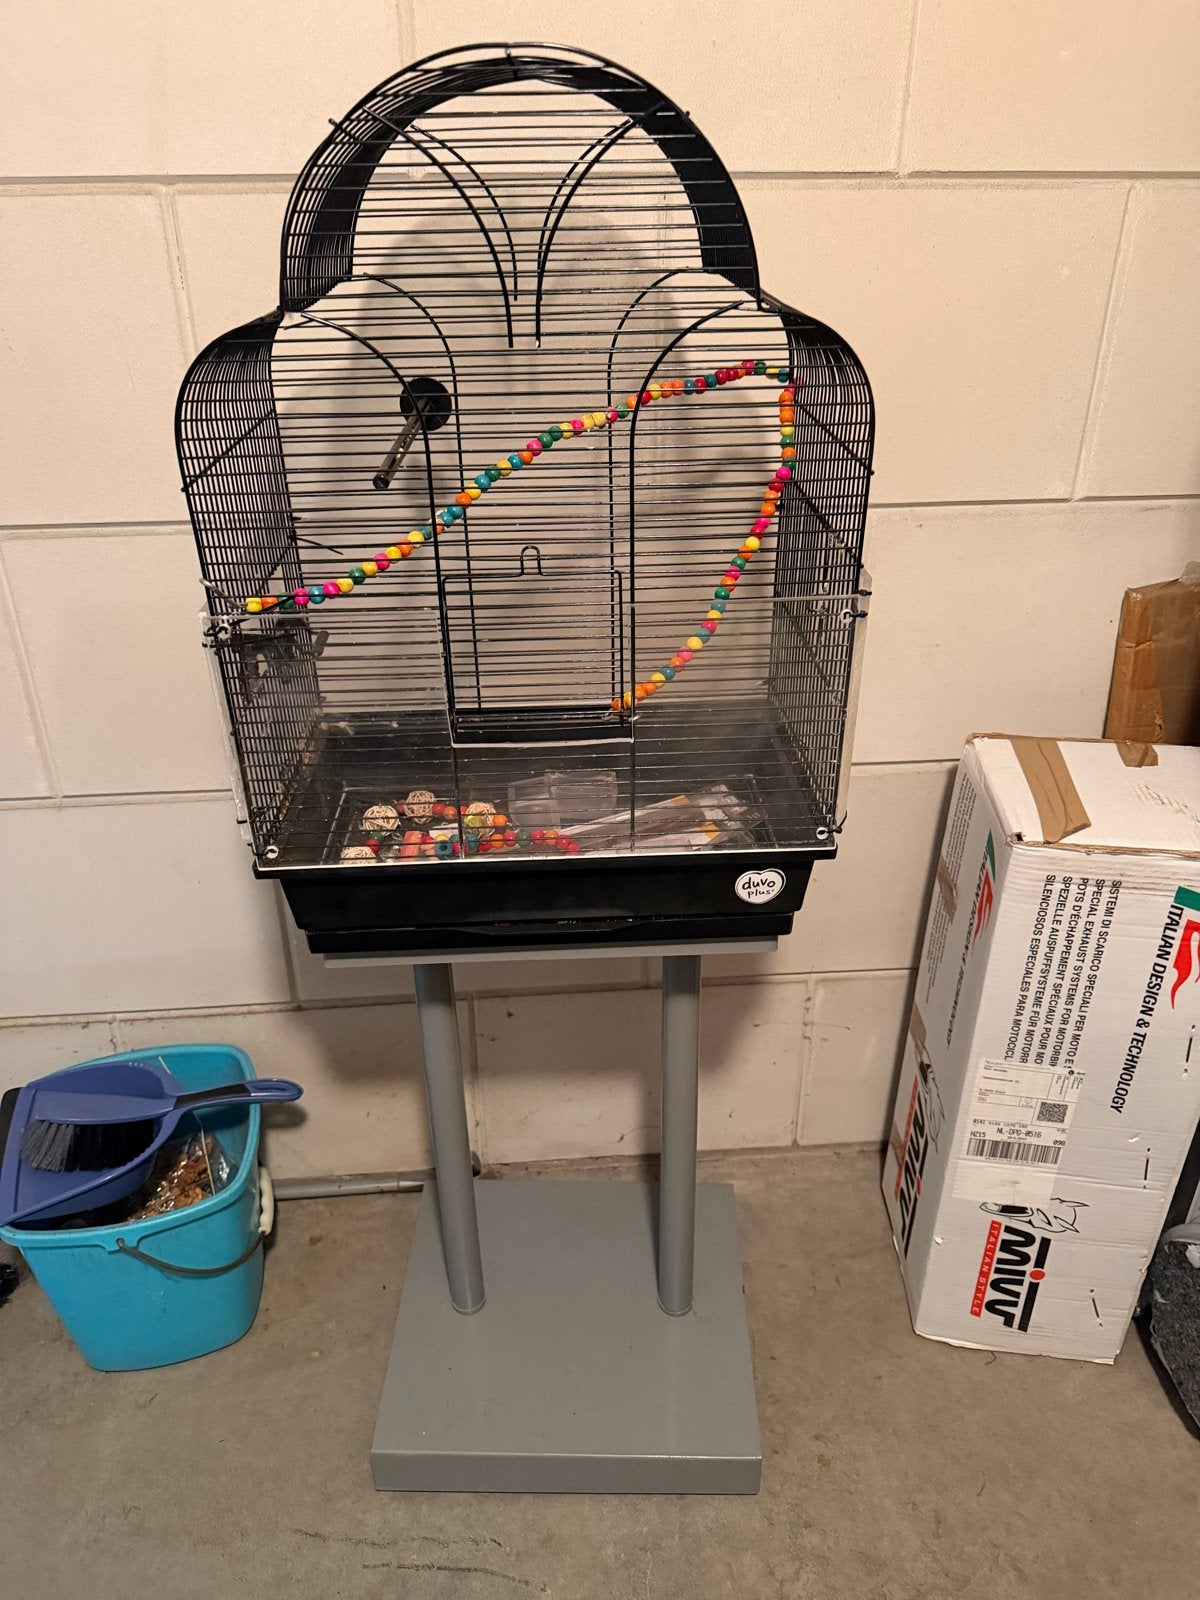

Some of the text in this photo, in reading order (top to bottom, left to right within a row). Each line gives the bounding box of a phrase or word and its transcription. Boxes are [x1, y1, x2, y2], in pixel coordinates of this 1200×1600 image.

[742, 877, 776, 890] duvo
[1052, 876, 1072, 925] SPEZIELLE
[1087, 879, 1105, 918] SPECIAL
[1104, 880, 1122, 917] SISTEMI
[1076, 921, 1094, 963] EXHAUST
[1101, 919, 1111, 929] DI
[1004, 874, 1056, 1062] SILENCIOSOS ESPECIALES PARA MOTOCICL
[1032, 927, 1060, 1008] AUSPUFFSYSTEME
[1090, 931, 1109, 971] SCARICO
[1034, 878, 1088, 1065] POTS D'ÉCHAPPEMENT SPÉCIAUX POUR MO
[1065, 965, 1083, 1006] SYSTEMS
[1079, 974, 1097, 1013] SPECIALI
[1109, 904, 1184, 1114] ITALIAN DESIGN & TECHNOLOGY
[1027, 1011, 1041, 1027] FÜR
[1060, 1008, 1072, 1024] FOR
[1075, 1015, 1087, 1032] PER
[1067, 1034, 1082, 1056] MOTO
[972, 1222, 999, 1314] ITALIAN STYLE
